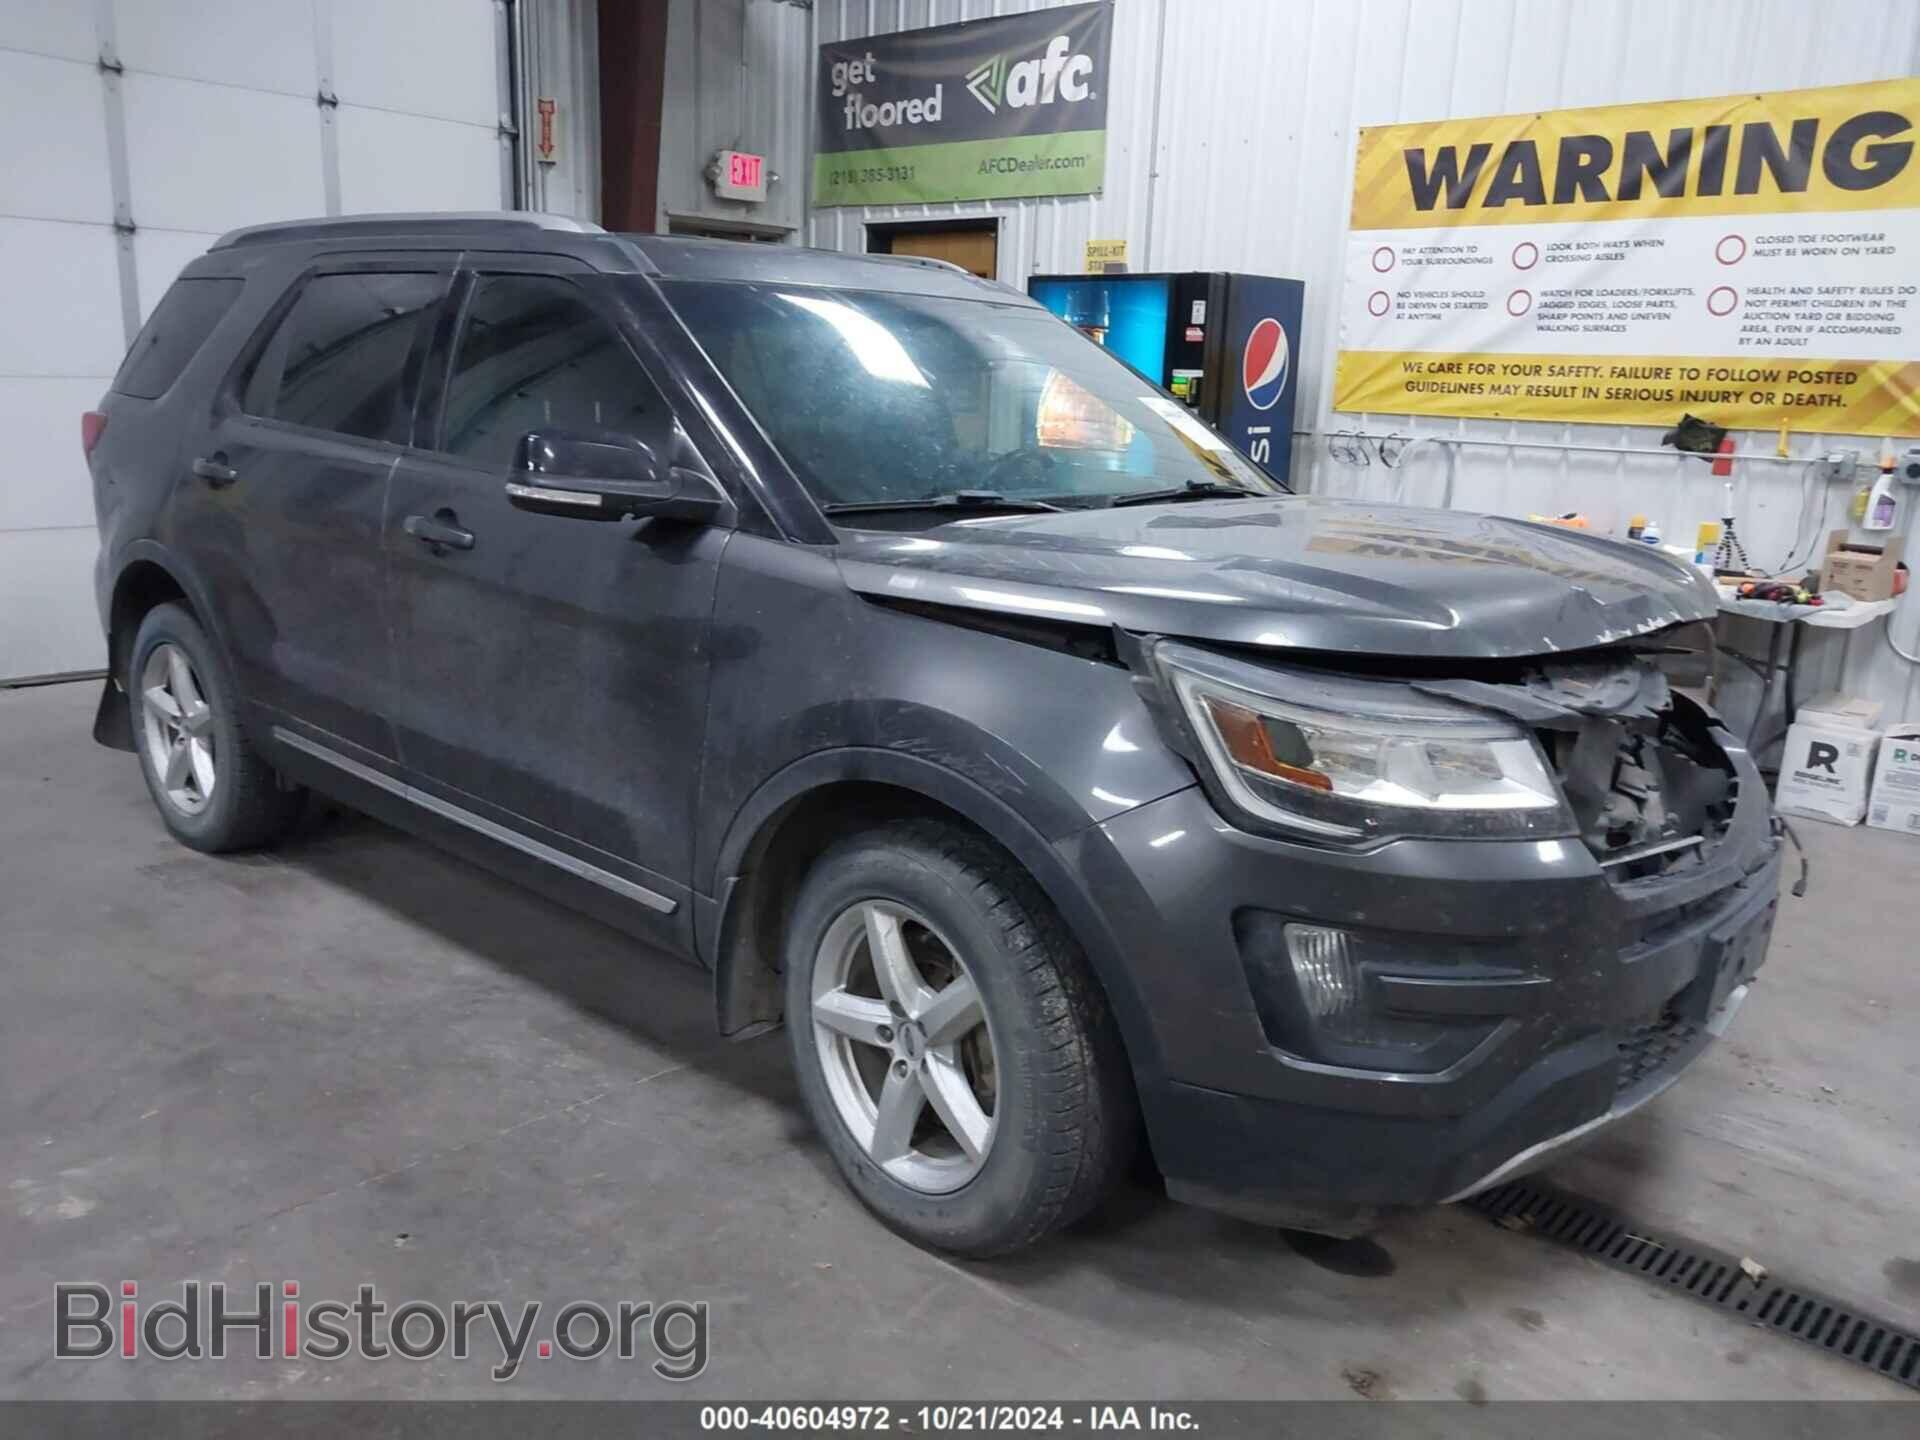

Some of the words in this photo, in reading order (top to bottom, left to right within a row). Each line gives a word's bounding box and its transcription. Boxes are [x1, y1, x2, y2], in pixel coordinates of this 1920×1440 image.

[831, 52, 877, 97] get
[844, 83, 943, 130] floored
[1403, 110, 1915, 212] WARNING
[732, 155, 761, 188] EXIT
[1755, 235, 1794, 245] CLOSED
[1797, 234, 1817, 244] TOE
[1821, 233, 1886, 243] FOOTWEAR
[1401, 247, 1416, 255] PAY
[1418, 245, 1463, 255] ATTENTION
[1466, 245, 1478, 254] TO
[1546, 242, 1573, 251] LOOK
[1575, 241, 1600, 251] BOTH
[1603, 240, 1630, 249] WAYS
[1633, 239, 1665, 248] WHEN
[1087, 245, 1125, 257] SPILL-KIT
[1753, 248, 1782, 257] MUST
[1785, 247, 1797, 256] BE
[1801, 247, 1838, 256] WORN
[1841, 246, 1860, 255] ON
[1865, 245, 1896, 255] YARD
[1401, 257, 1423, 266] YOUR
[1425, 256, 1494, 265] SURROUNDINGS
[1545, 253, 1592, 263] CROSSING
[1595, 252, 1625, 262] AISLES
[1451, 290, 1486, 298] SHOULD
[1540, 289, 1573, 297] WATCH
[1574, 289, 1594, 297] FOR
[1746, 286, 1786, 295] HEALTH
[1789, 286, 1813, 295] AND
[1817, 286, 1855, 295] SAFETY
[1859, 286, 1894, 295] RULES
[1897, 285, 1917, 295] DO
[1538, 301, 1575, 310] JAGGED
[1612, 300, 1643, 309] LOOSE
[1744, 299, 1767, 308] NOT
[1770, 299, 1808, 308] PERMIT
[1811, 299, 1864, 308] CHILDREN
[1867, 299, 1881, 308] IN
[1885, 299, 1907, 308] THE
[1537, 312, 1568, 321] SHARP
[1570, 312, 1604, 321] POINTS
[1606, 312, 1629, 321] AND
[1631, 312, 1672, 321] UNEVEN
[1742, 312, 1790, 321] AUCTION
[1793, 312, 1823, 321] YARD
[1825, 312, 1842, 321] OR
[1845, 312, 1895, 322] BIDDING
[1536, 324, 1580, 333] WALKING
[1582, 324, 1627, 333] SURFACES
[1774, 324, 1802, 333] EVEN
[1805, 324, 1815, 333] IF
[1817, 325, 1902, 335] ACCOMPANIED
[1738, 337, 1751, 346] BY
[1754, 337, 1771, 346] AN
[1774, 337, 1809, 346] ADULT
[1402, 361, 1423, 374] WE
[1427, 361, 1463, 375] CARE
[1467, 362, 1495, 376] FOR
[1501, 363, 1543, 377] YOUR
[1609, 366, 1673, 380] FAILURE
[1678, 367, 1700, 381] TO
[1706, 368, 1780, 383] FOLLOW
[1786, 370, 1858, 385] POSTED
[1404, 380, 1485, 395] GUIDELINES
[1488, 382, 1522, 396] MAY
[1525, 384, 1578, 399] RESULT
[1582, 385, 1600, 400] IN
[1604, 386, 1674, 402] SERIOUS
[1679, 388, 1744, 404] INJURY
[1749, 390, 1776, 406] OR
[1782, 392, 1848, 408] DEATH.
[1805, 740, 1839, 774] R
